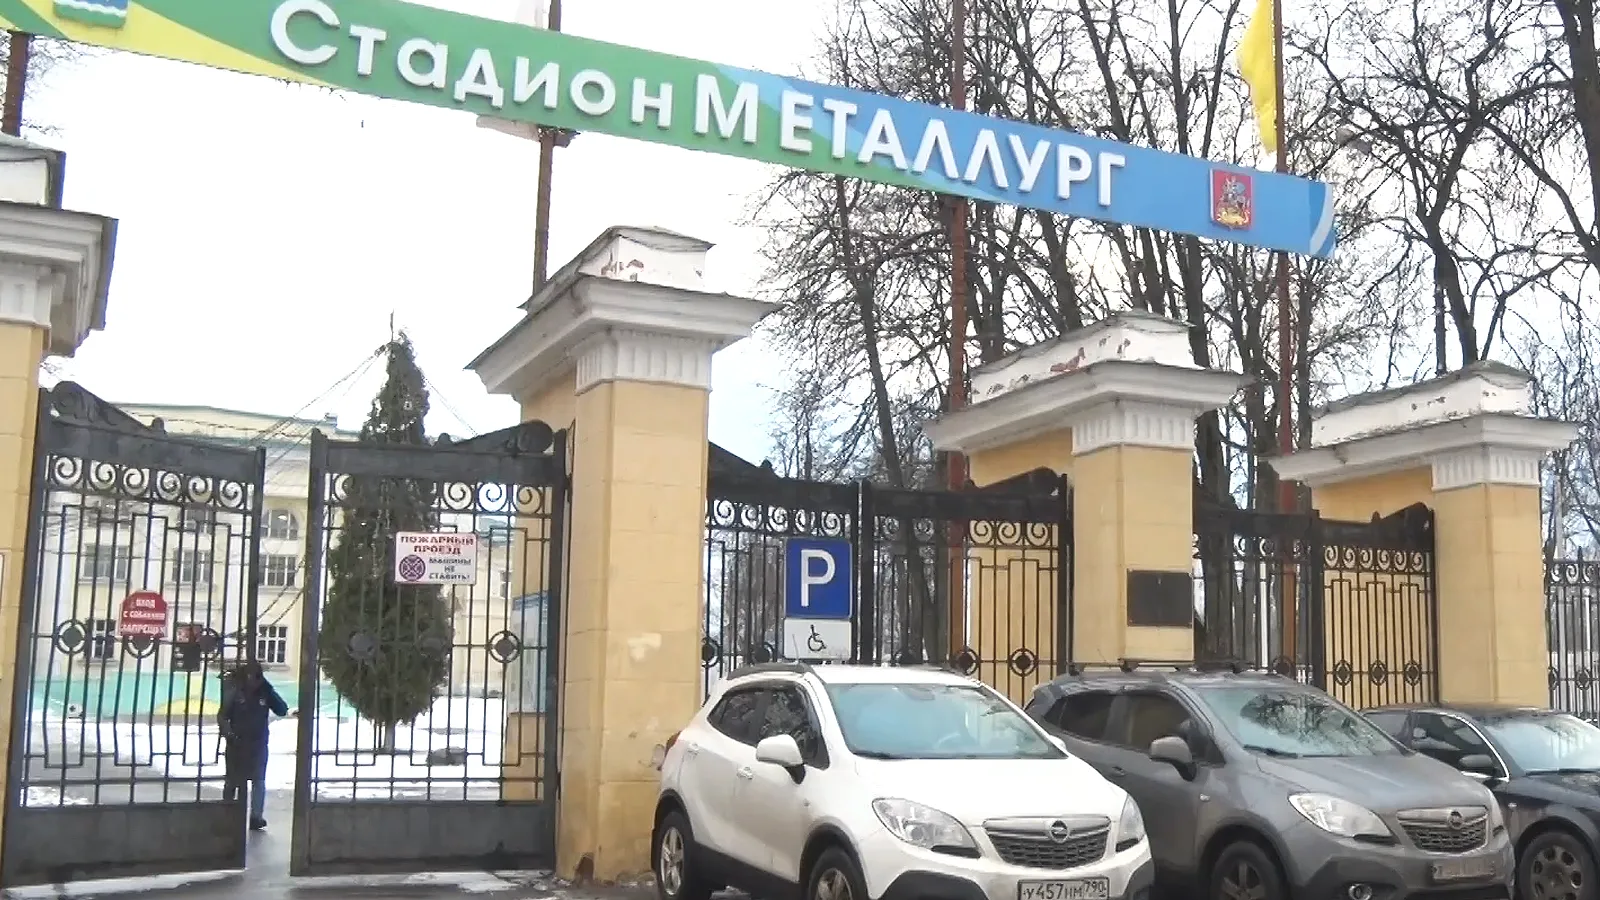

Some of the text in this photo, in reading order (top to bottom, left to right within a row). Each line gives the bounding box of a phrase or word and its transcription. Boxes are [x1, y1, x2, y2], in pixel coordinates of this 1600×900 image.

[400, 535, 474, 546] ПОЖАРНЫЙ
[413, 545, 461, 555] ПРОЕЗД
[428, 557, 471, 565] МАШИНЫ
[444, 565, 456, 573] НЕ
[800, 548, 836, 607] P
[129, 611, 165, 620] СОБАК
[121, 624, 164, 635] ЗАПРЕЩ
